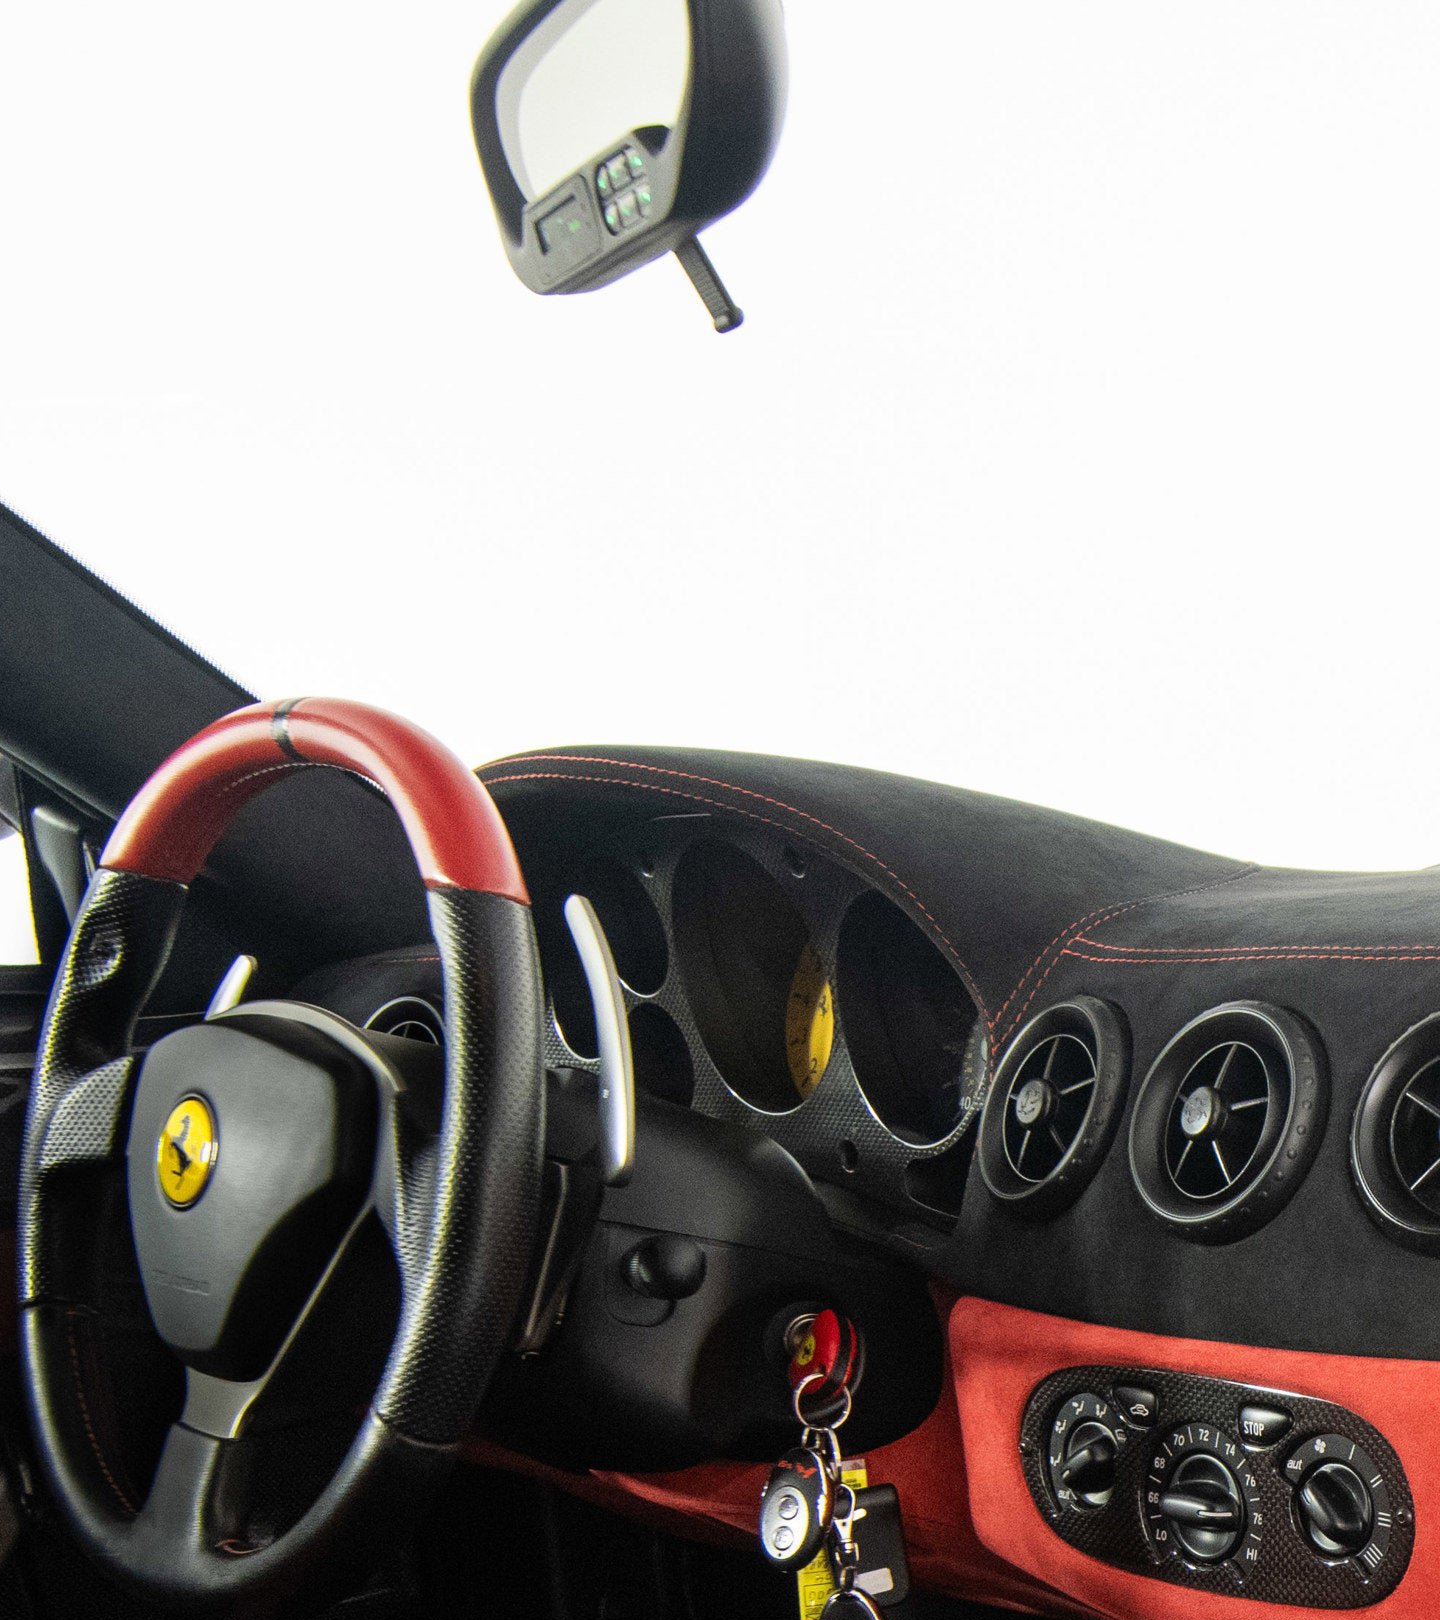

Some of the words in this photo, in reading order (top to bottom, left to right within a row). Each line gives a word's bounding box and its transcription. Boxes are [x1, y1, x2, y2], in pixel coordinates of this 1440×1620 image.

[1198, 1429, 1209, 1441] 72
[1243, 1421, 1264, 1437] STOP
[1173, 1434, 1185, 1446] 70
[1225, 1443, 1236, 1456] 74
[1154, 1456, 1166, 1469] 68
[1287, 1459, 1303, 1470] aut
[1245, 1475, 1256, 1487] 76
[1148, 1491, 1159, 1503] 66
[1253, 1512, 1263, 1525] 78
[1156, 1529, 1167, 1541] LO
[1246, 1548, 1258, 1560] HI
